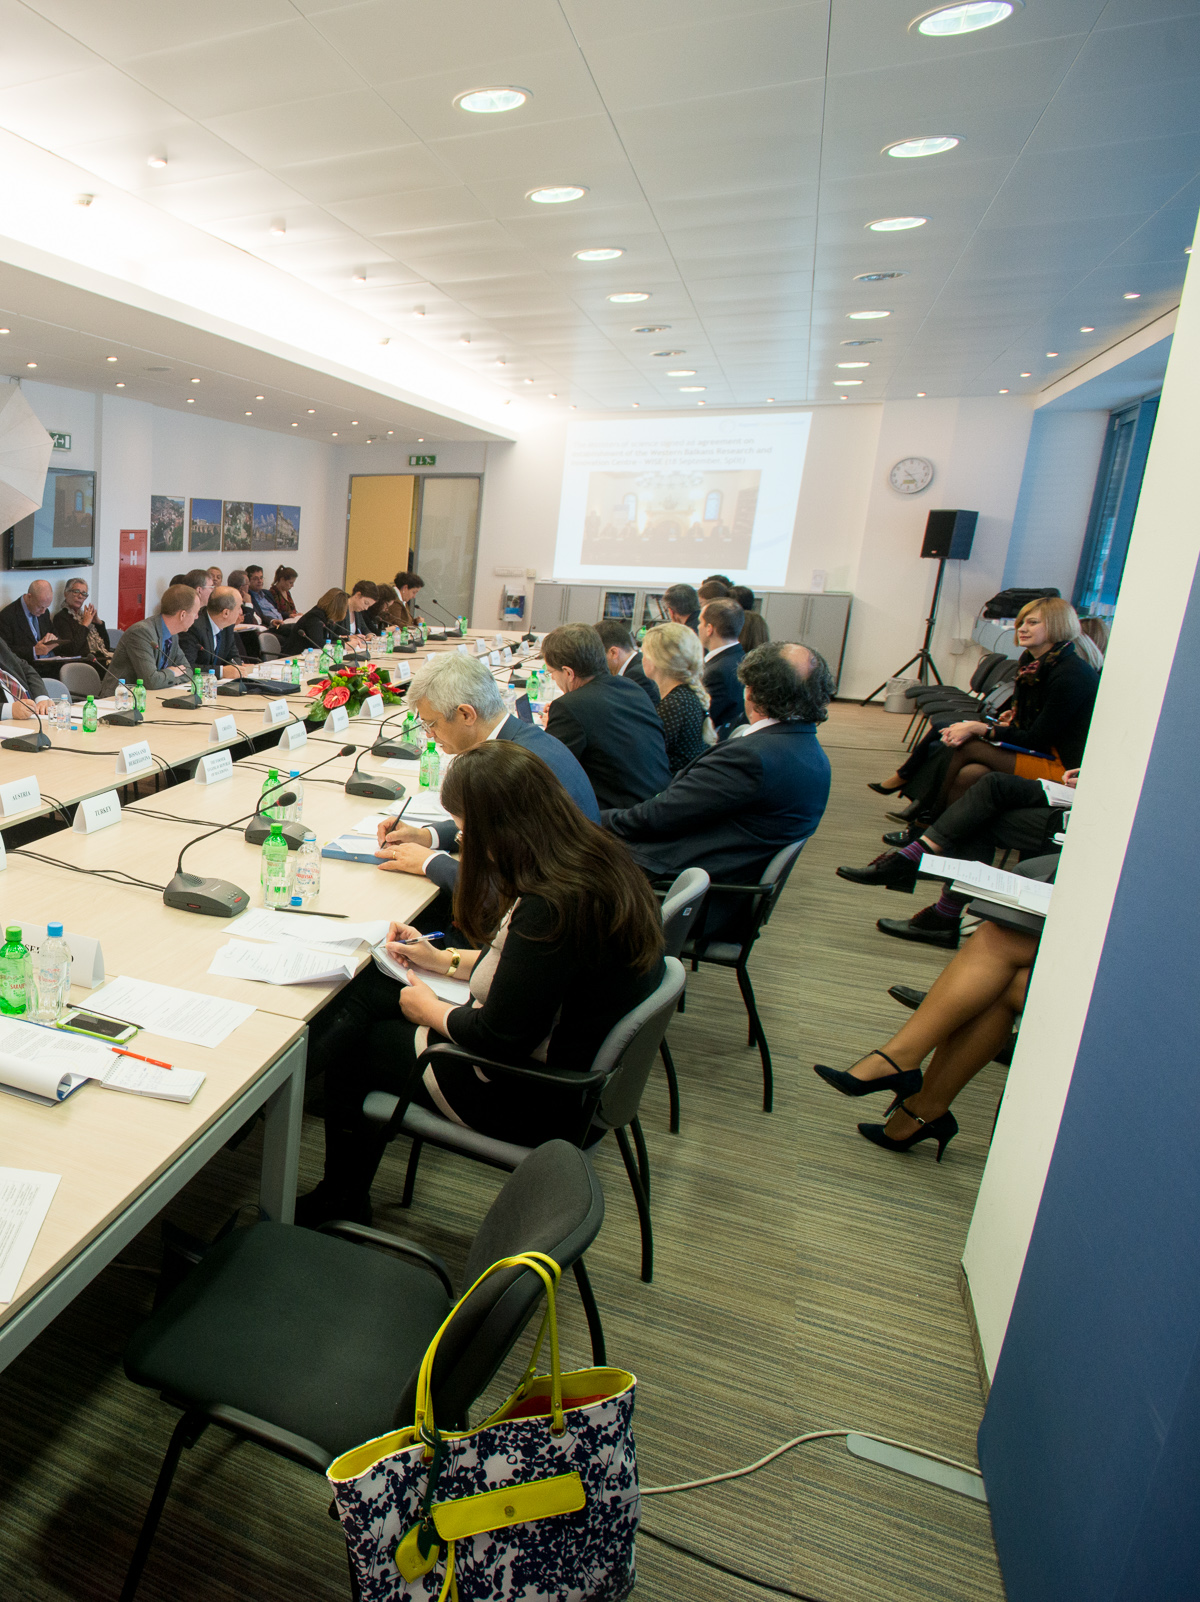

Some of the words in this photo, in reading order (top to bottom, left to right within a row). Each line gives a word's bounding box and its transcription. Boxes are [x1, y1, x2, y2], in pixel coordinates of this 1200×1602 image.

[697, 439, 742, 447] agreement
[755, 446, 773, 454] and
[130, 550, 138, 566] H
[12, 790, 32, 801] AUSTRIA
[94, 805, 112, 817] TURKEY
